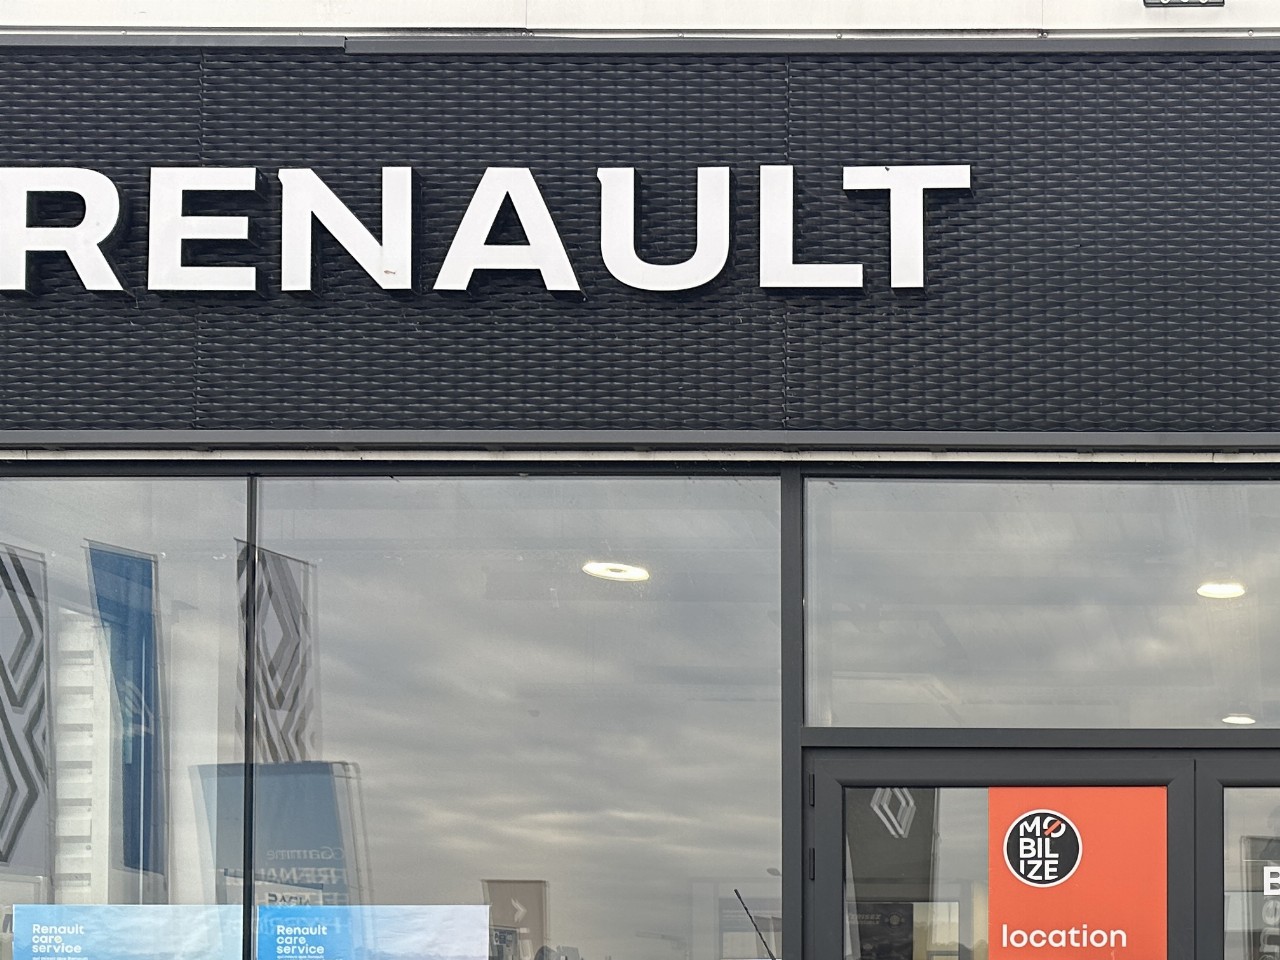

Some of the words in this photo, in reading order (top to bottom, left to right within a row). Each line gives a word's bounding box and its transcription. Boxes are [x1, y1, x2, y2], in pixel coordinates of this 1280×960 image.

[0, 164, 972, 291] RENAULT
[32, 923, 85, 935] Renault
[276, 924, 328, 936] Renault
[32, 934, 63, 944] care
[276, 936, 306, 945] care
[1001, 924, 1127, 948] location
[32, 943, 82, 954] service
[276, 943, 325, 955] service
